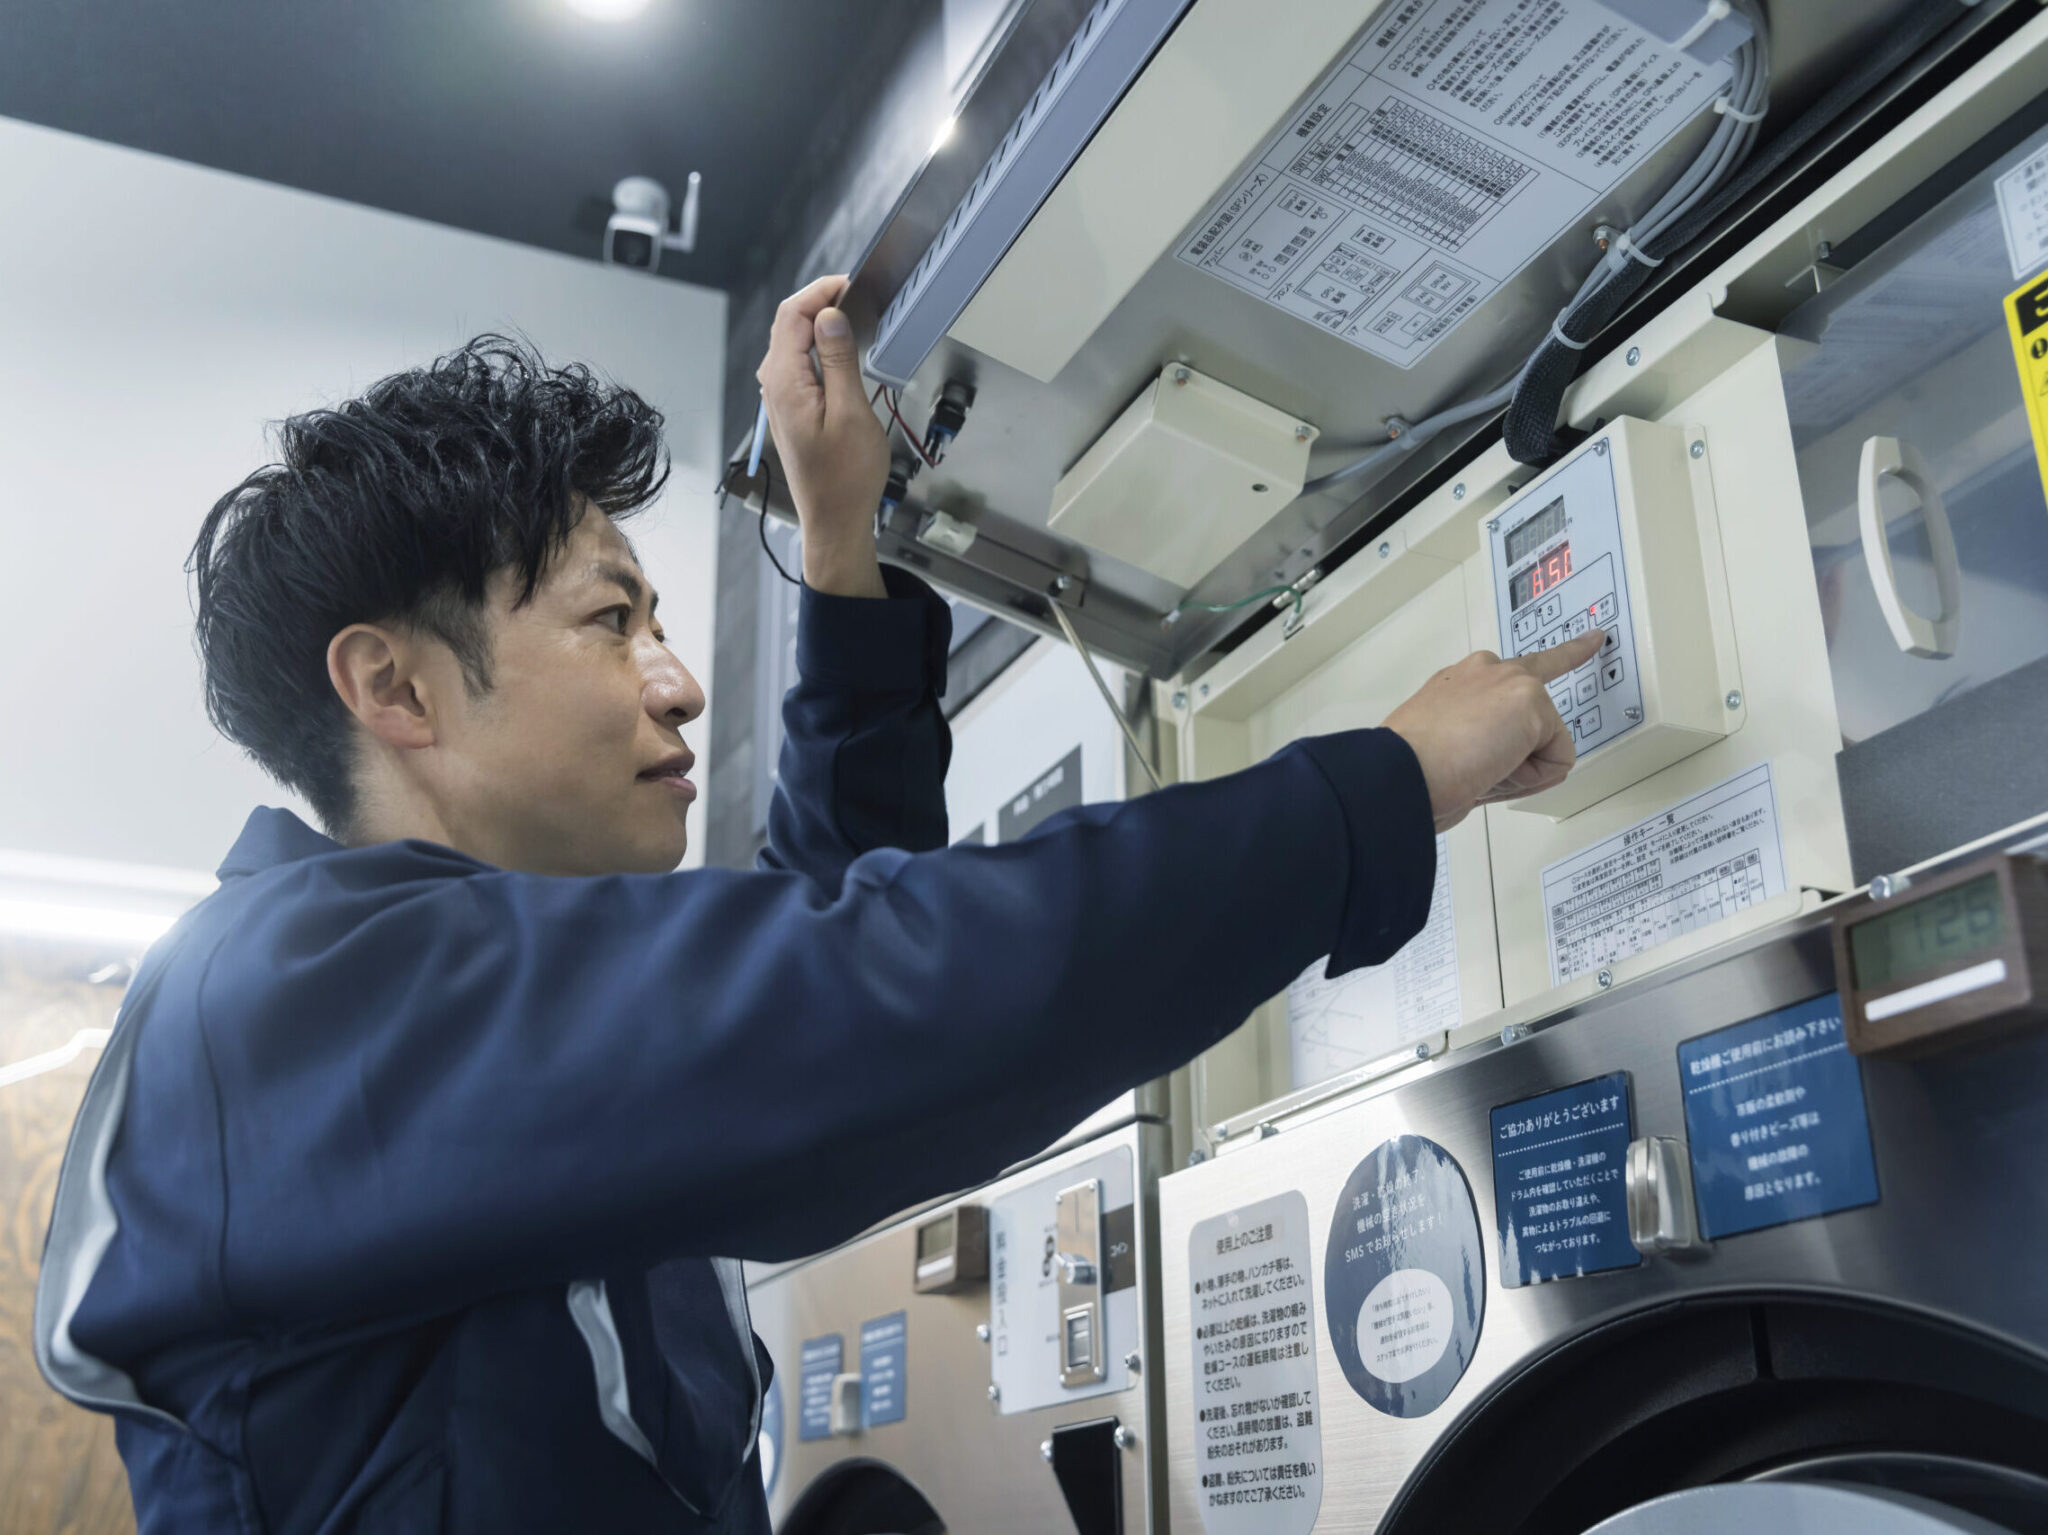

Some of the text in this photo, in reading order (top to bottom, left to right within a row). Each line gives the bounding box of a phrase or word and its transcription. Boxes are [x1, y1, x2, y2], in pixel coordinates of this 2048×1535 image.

[1294, 102, 1332, 138] 機種設定
[1547, 603, 1553, 616] 3
[1524, 620, 1529, 631] 1
[1550, 634, 1556, 647] 4
[1499, 1094, 1620, 1140] ご協力ありがとうございます
[1517, 1151, 1606, 1181] ご使用前に乾燥機・洗濯機の
[1510, 1168, 1618, 1202] ドラム内を確認していただくことで
[1528, 1192, 1600, 1217] 洗濯物のお取り違えや、
[1521, 1209, 1611, 1238] 異物によるトラブルの回避に
[1215, 1222, 1273, 1255] 使用上のご注意
[1534, 1232, 1601, 1255] つながっております。
[1344, 1242, 1364, 1264] SMS
[1204, 1374, 1241, 1394] てください。
